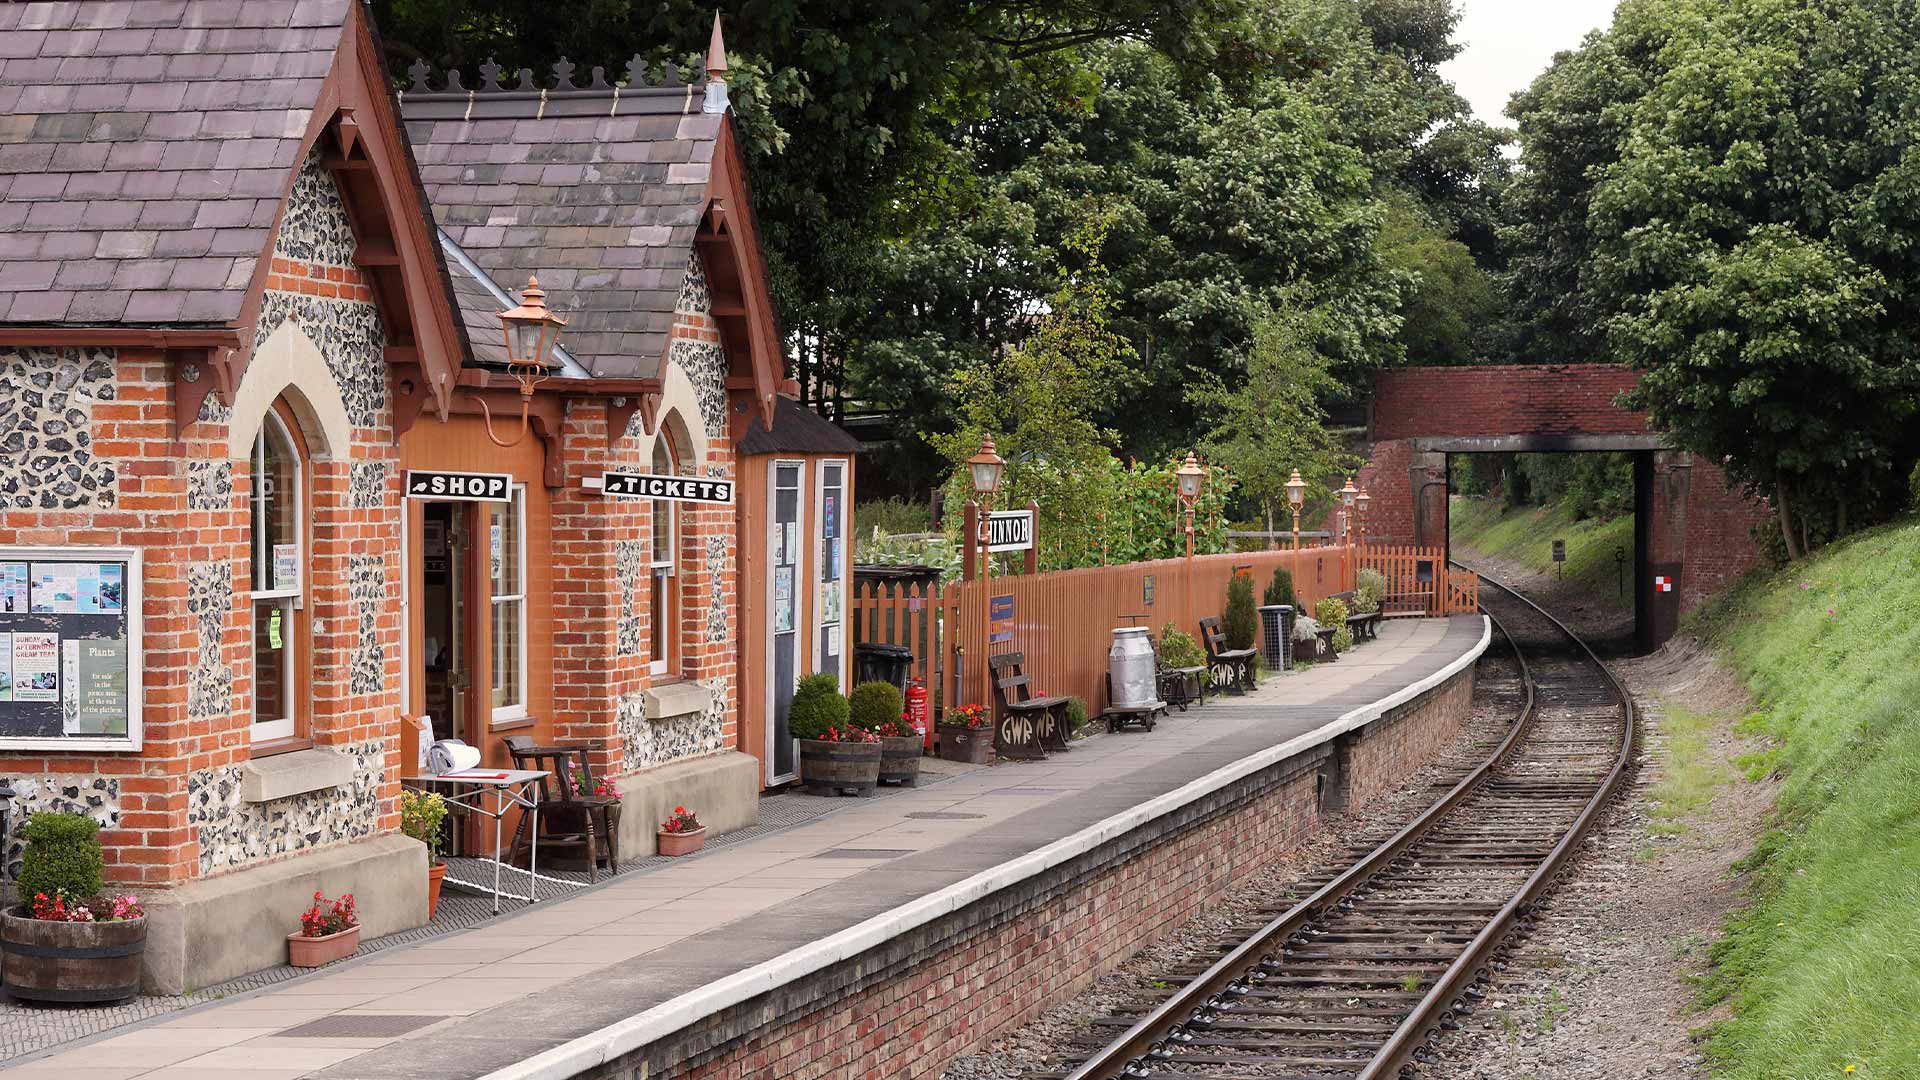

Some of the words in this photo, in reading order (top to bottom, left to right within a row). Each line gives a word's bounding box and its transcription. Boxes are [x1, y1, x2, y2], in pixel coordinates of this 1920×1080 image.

[431, 476, 503, 496] SHOP
[624, 477, 728, 500] TICKETS
[89, 647, 116, 657] Plants
[1211, 663, 1235, 686] GWR
[1002, 716, 1033, 744] GWR
